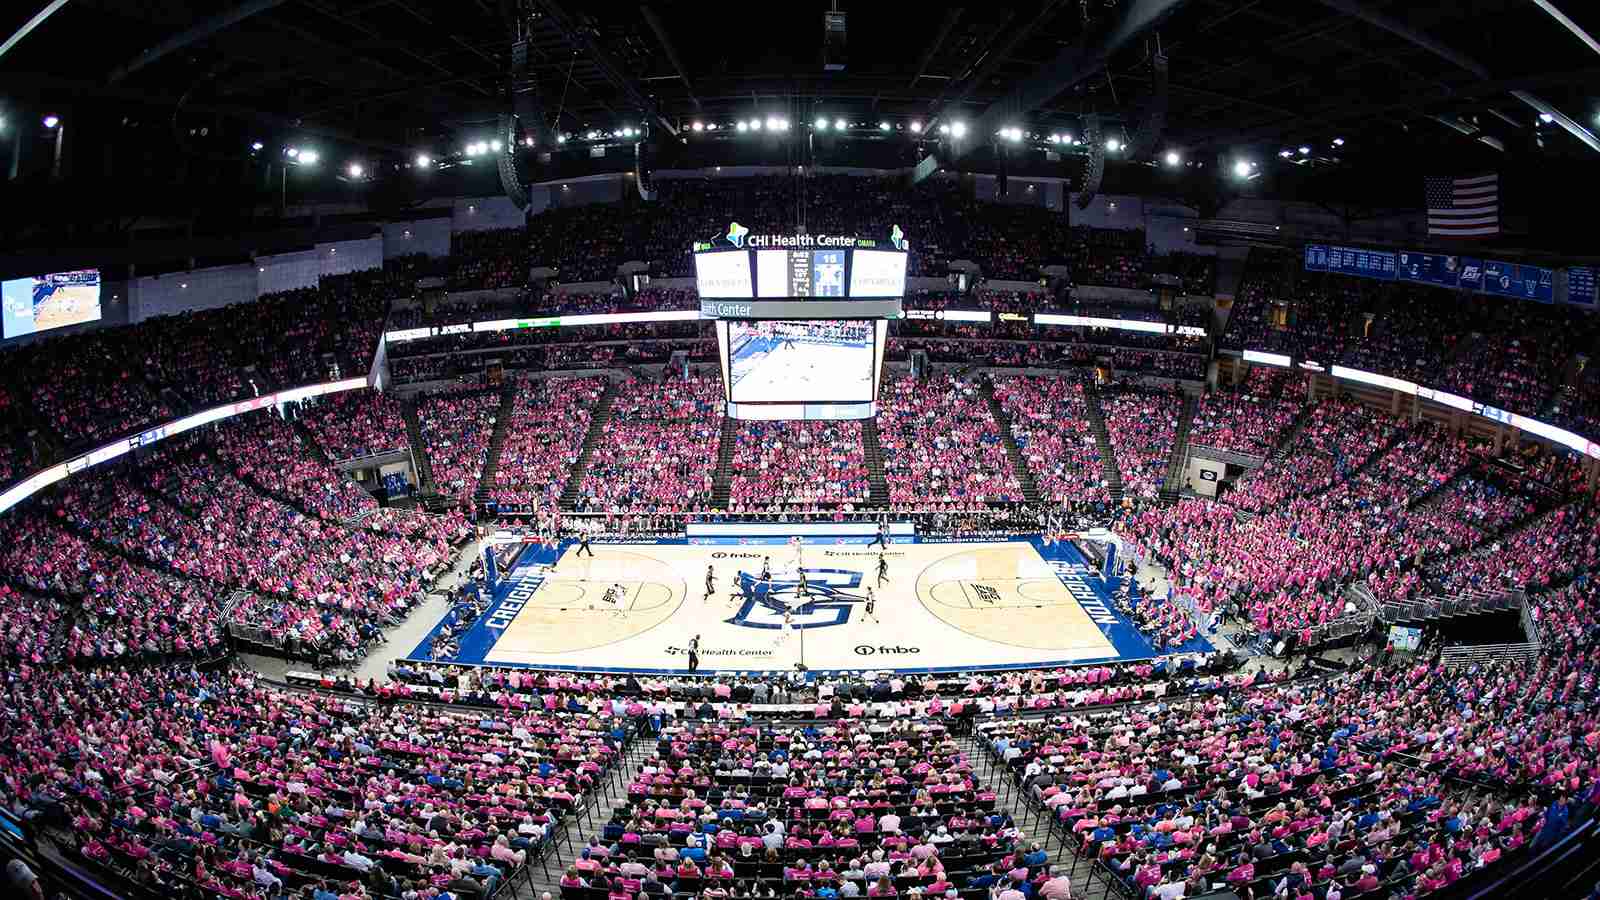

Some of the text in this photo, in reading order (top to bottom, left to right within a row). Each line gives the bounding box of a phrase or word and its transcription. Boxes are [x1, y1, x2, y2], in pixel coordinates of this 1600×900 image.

[747, 234, 856, 247] CHI Health Center
[717, 303, 750, 317] Center
[877, 644, 921, 655] fnbo
